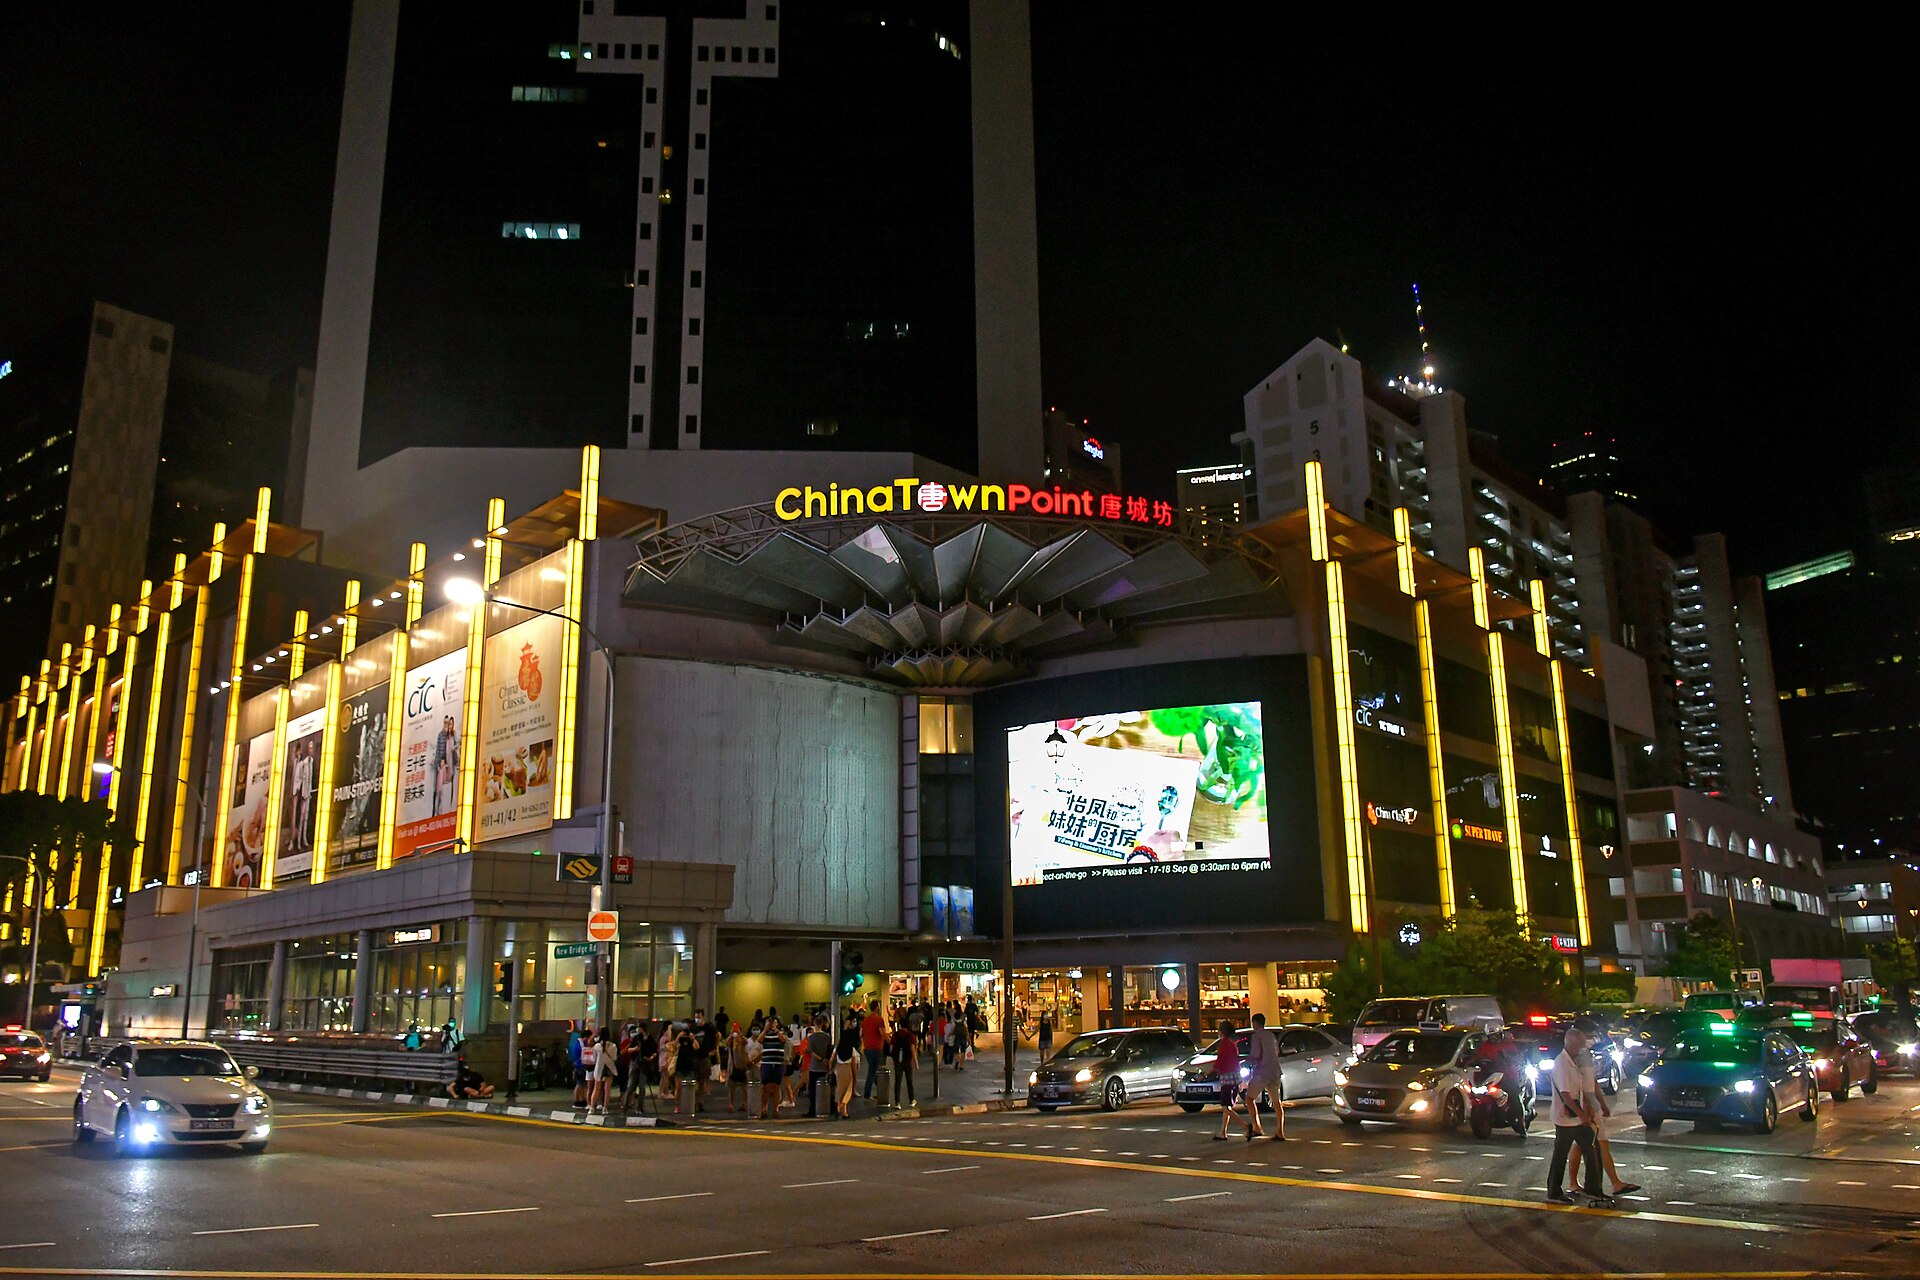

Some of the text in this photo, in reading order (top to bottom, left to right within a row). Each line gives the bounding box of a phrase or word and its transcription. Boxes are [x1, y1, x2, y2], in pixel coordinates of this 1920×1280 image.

[1100, 494, 1173, 527] 唐城坊
[481, 808, 517, 828] #01-41/42
[1375, 806, 1390, 819] China
[1464, 824, 1483, 840] SUPER
[1043, 871, 1087, 881] ect-on-the-go
[1102, 867, 1126, 877] Please
[1128, 866, 1142, 876] visit
[1149, 865, 1171, 874] 17-18
[1171, 864, 1188, 875] Sep
[1189, 864, 1198, 874] @
[1200, 862, 1229, 872] 9:30am
[1231, 862, 1240, 871] to
[1240, 861, 1259, 872] 6pm
[555, 943, 597, 956] New Bridge Rd
[940, 959, 989, 970] Upp Cross St
